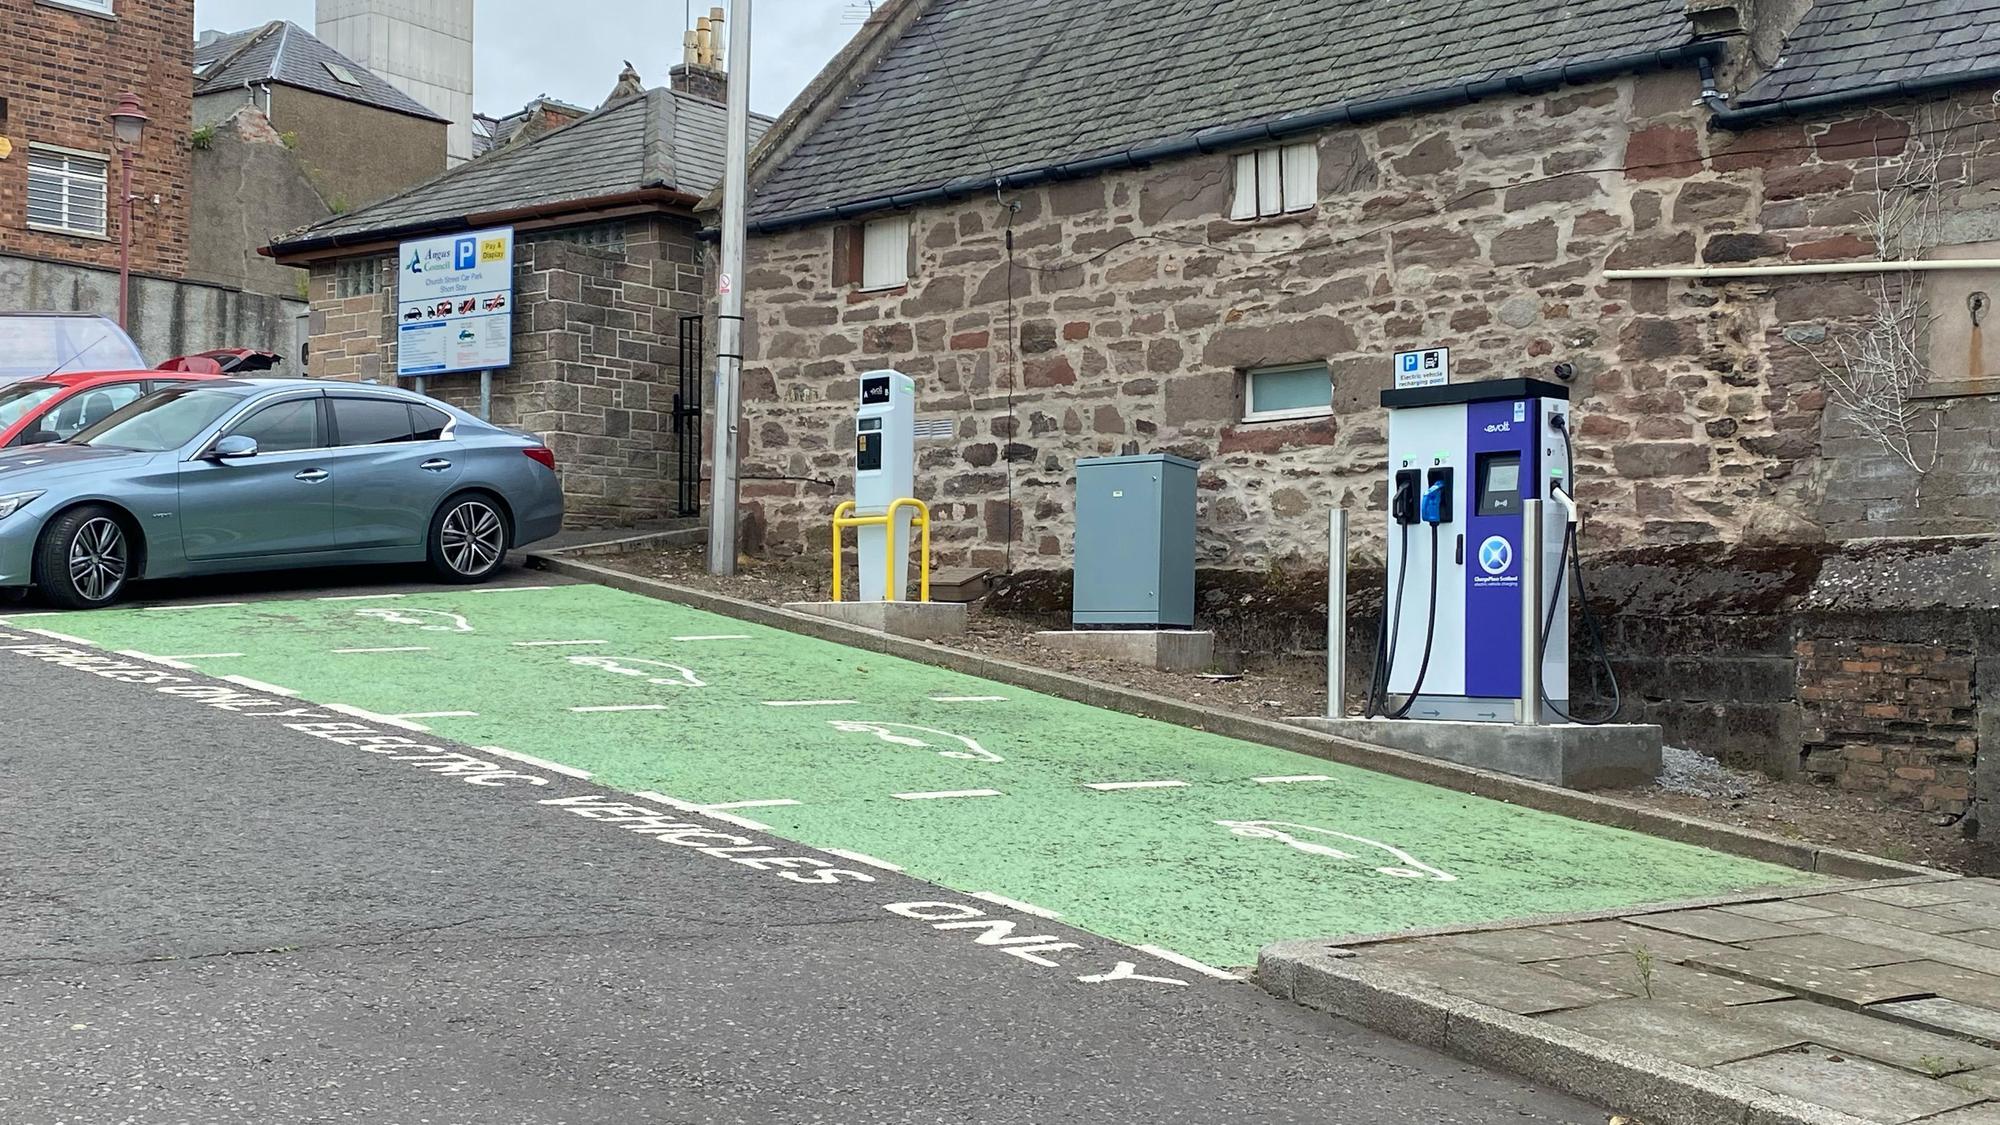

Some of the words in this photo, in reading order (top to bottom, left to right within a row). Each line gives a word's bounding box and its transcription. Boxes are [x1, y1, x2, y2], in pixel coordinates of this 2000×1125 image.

[485, 242, 496, 251] Pay
[424, 248, 450, 260] Angus
[460, 241, 474, 267] P
[482, 250, 504, 259] Display
[424, 261, 450, 271] Council
[471, 272, 483, 280] Park
[455, 284, 468, 292] Stay
[1405, 356, 1415, 370] P
[1399, 379, 1428, 387] recharging
[1484, 421, 1511, 432] evolt
[155, 686, 331, 718] ONLY
[282, 722, 549, 786] ELECTRIC
[538, 795, 876, 884] VEHICLES
